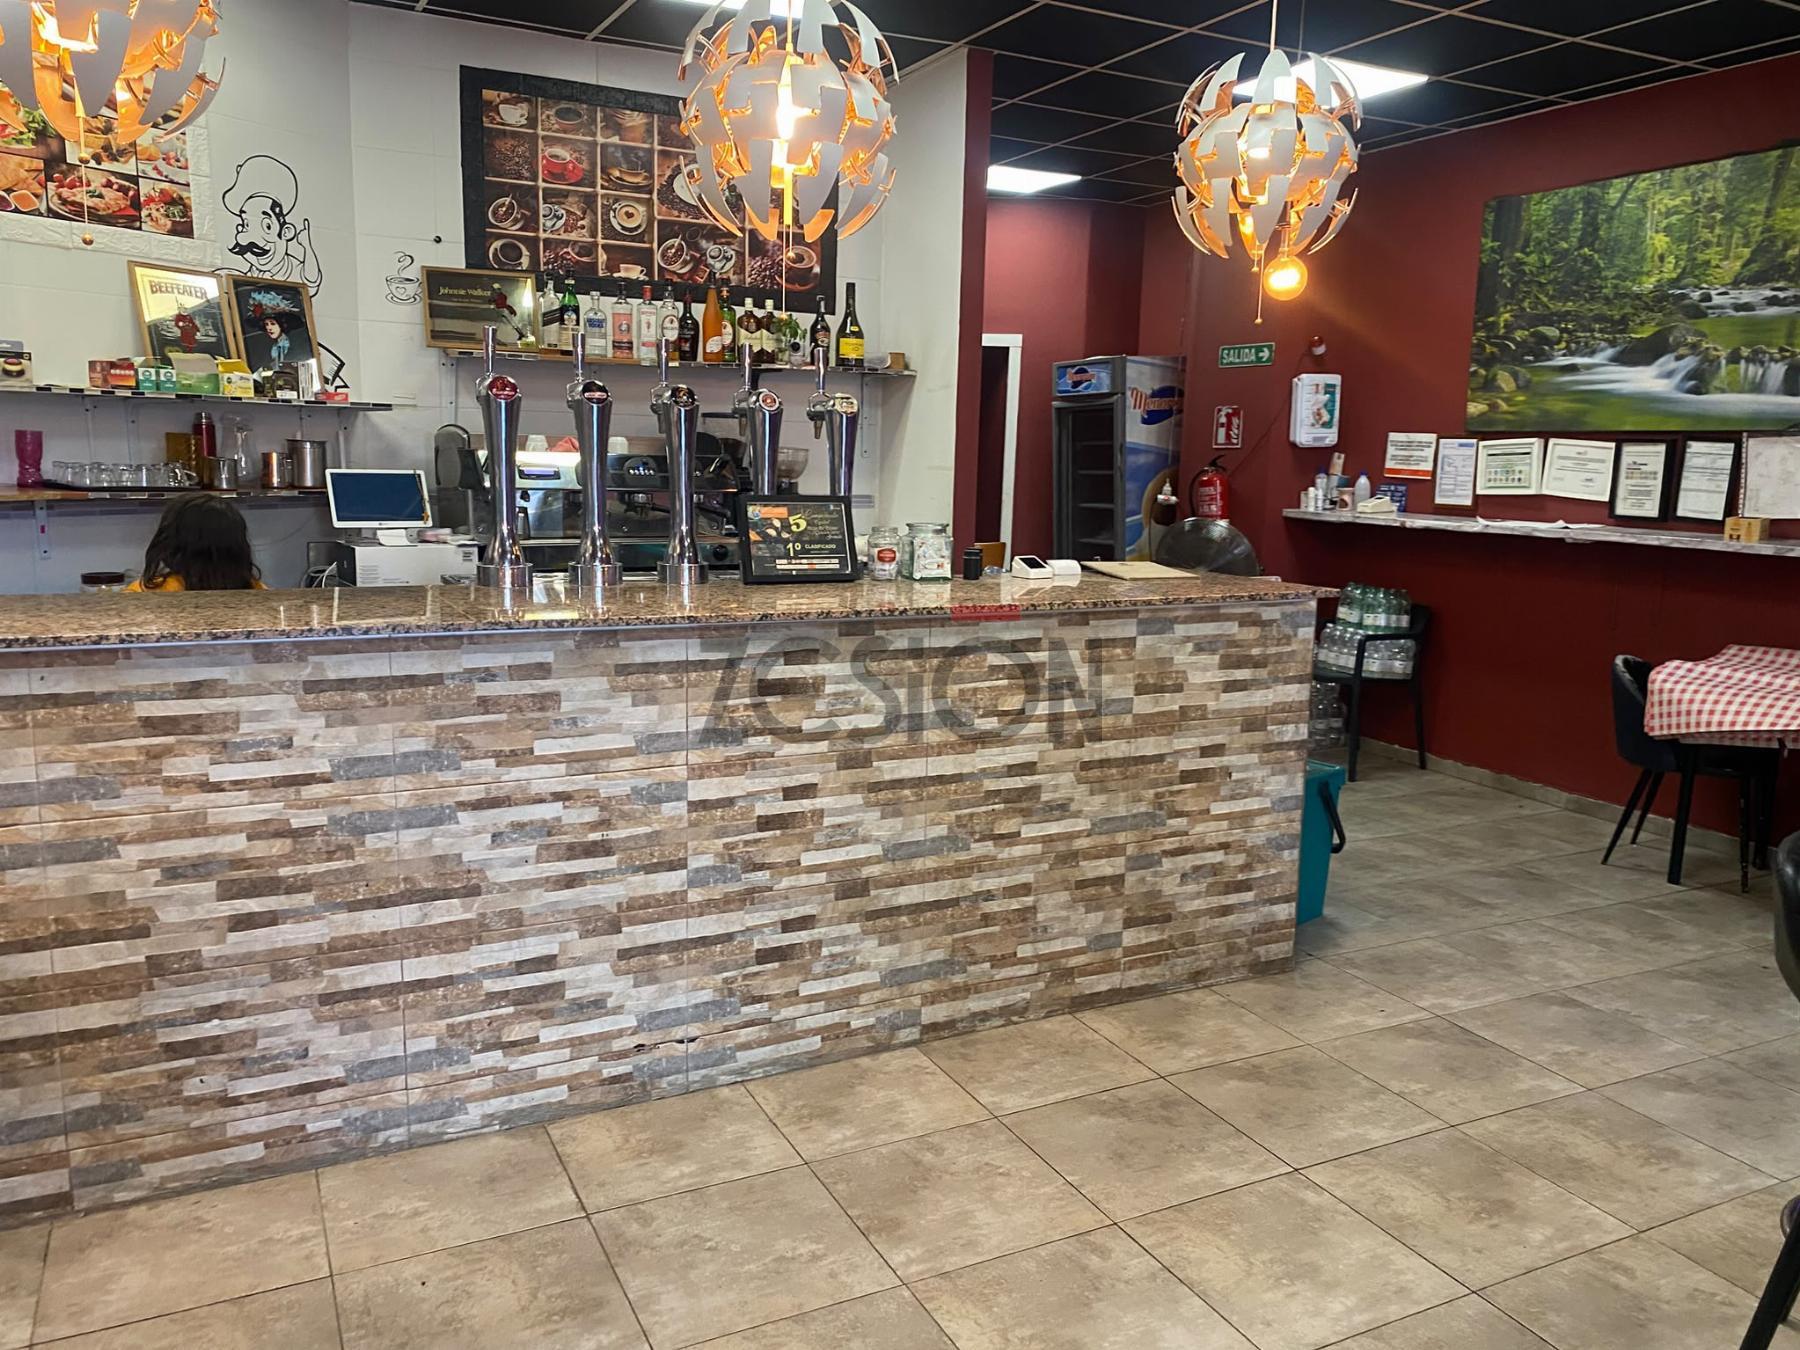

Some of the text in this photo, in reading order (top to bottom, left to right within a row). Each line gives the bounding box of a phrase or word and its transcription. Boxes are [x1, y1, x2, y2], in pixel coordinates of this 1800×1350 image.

[149, 279, 208, 300] BEEFEATER
[439, 286, 492, 297] Johnnie Walker
[1222, 348, 1256, 364] SALIDA
[788, 513, 807, 532] 5
